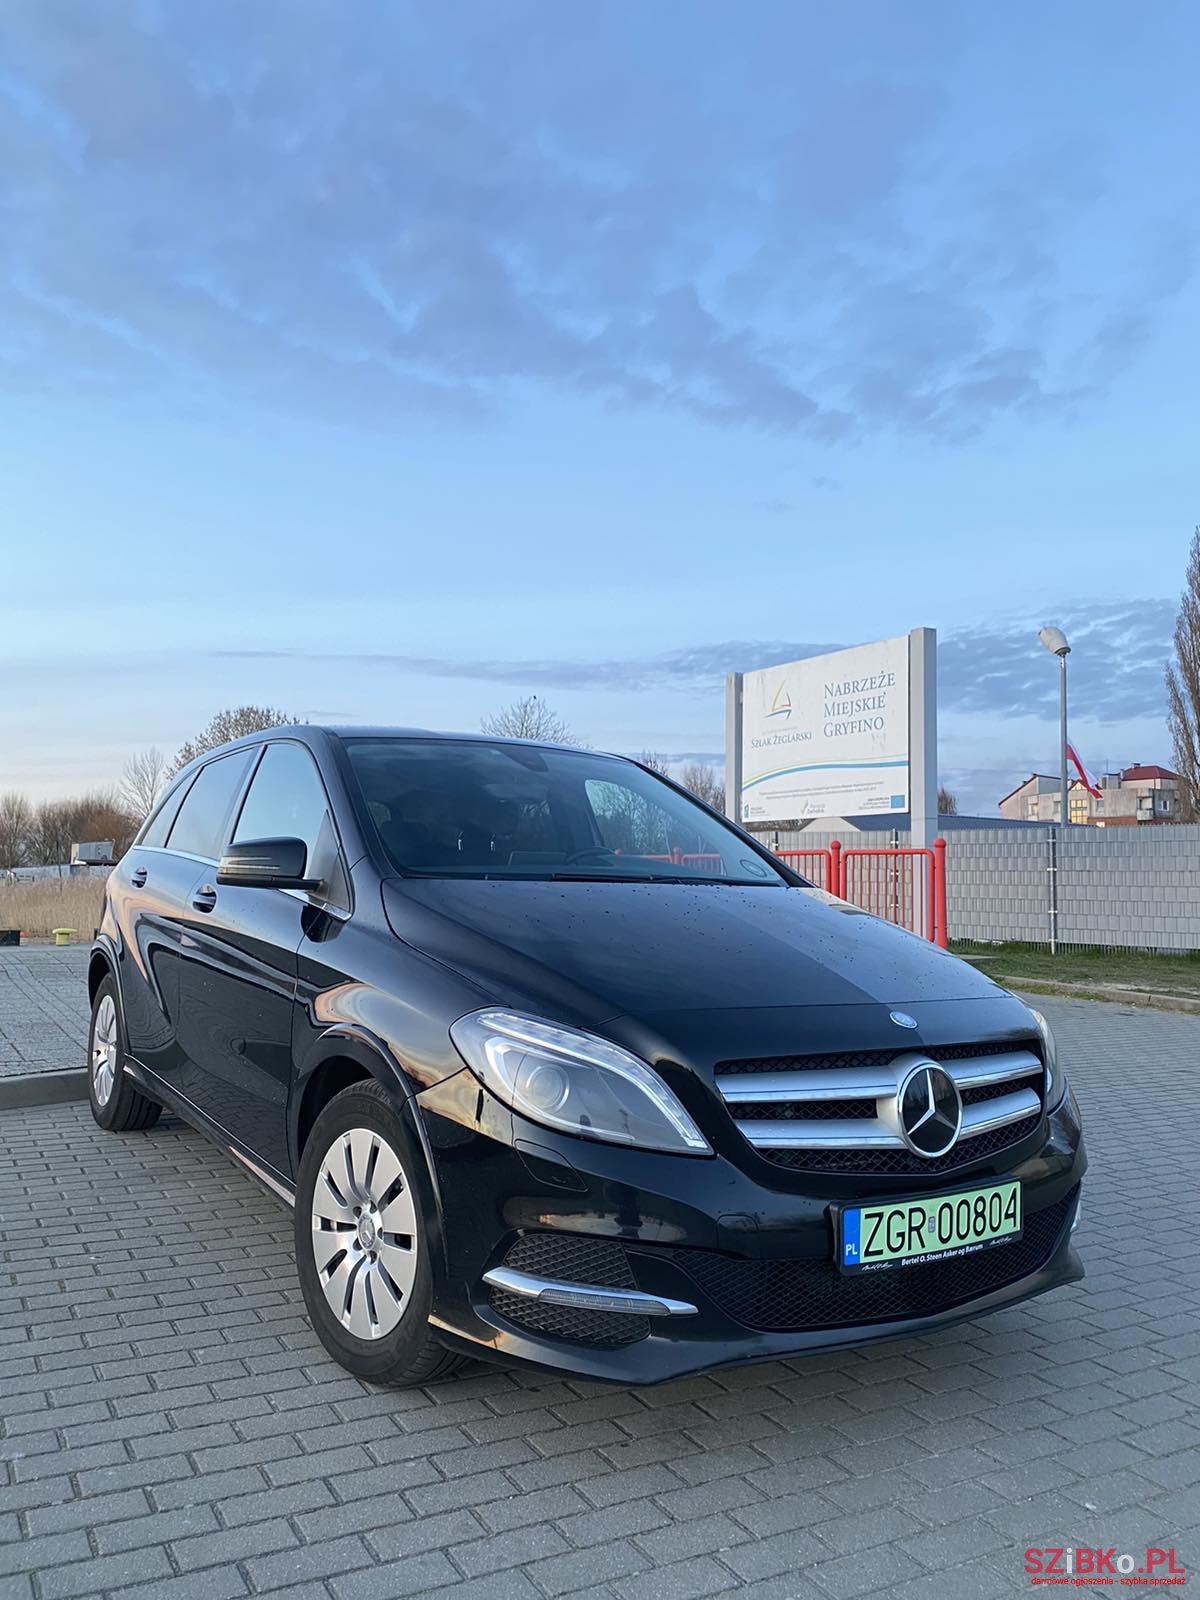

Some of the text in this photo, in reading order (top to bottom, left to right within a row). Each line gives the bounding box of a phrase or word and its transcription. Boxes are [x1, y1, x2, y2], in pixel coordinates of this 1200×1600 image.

[824, 694, 886, 718] MIEJSKIE
[823, 716, 884, 738] GRYFINO
[863, 1187, 1017, 1258] ZGR 00804
[845, 1243, 858, 1257] PL
[901, 1255, 920, 1266] Bertel
[926, 1253, 943, 1262] Steen
